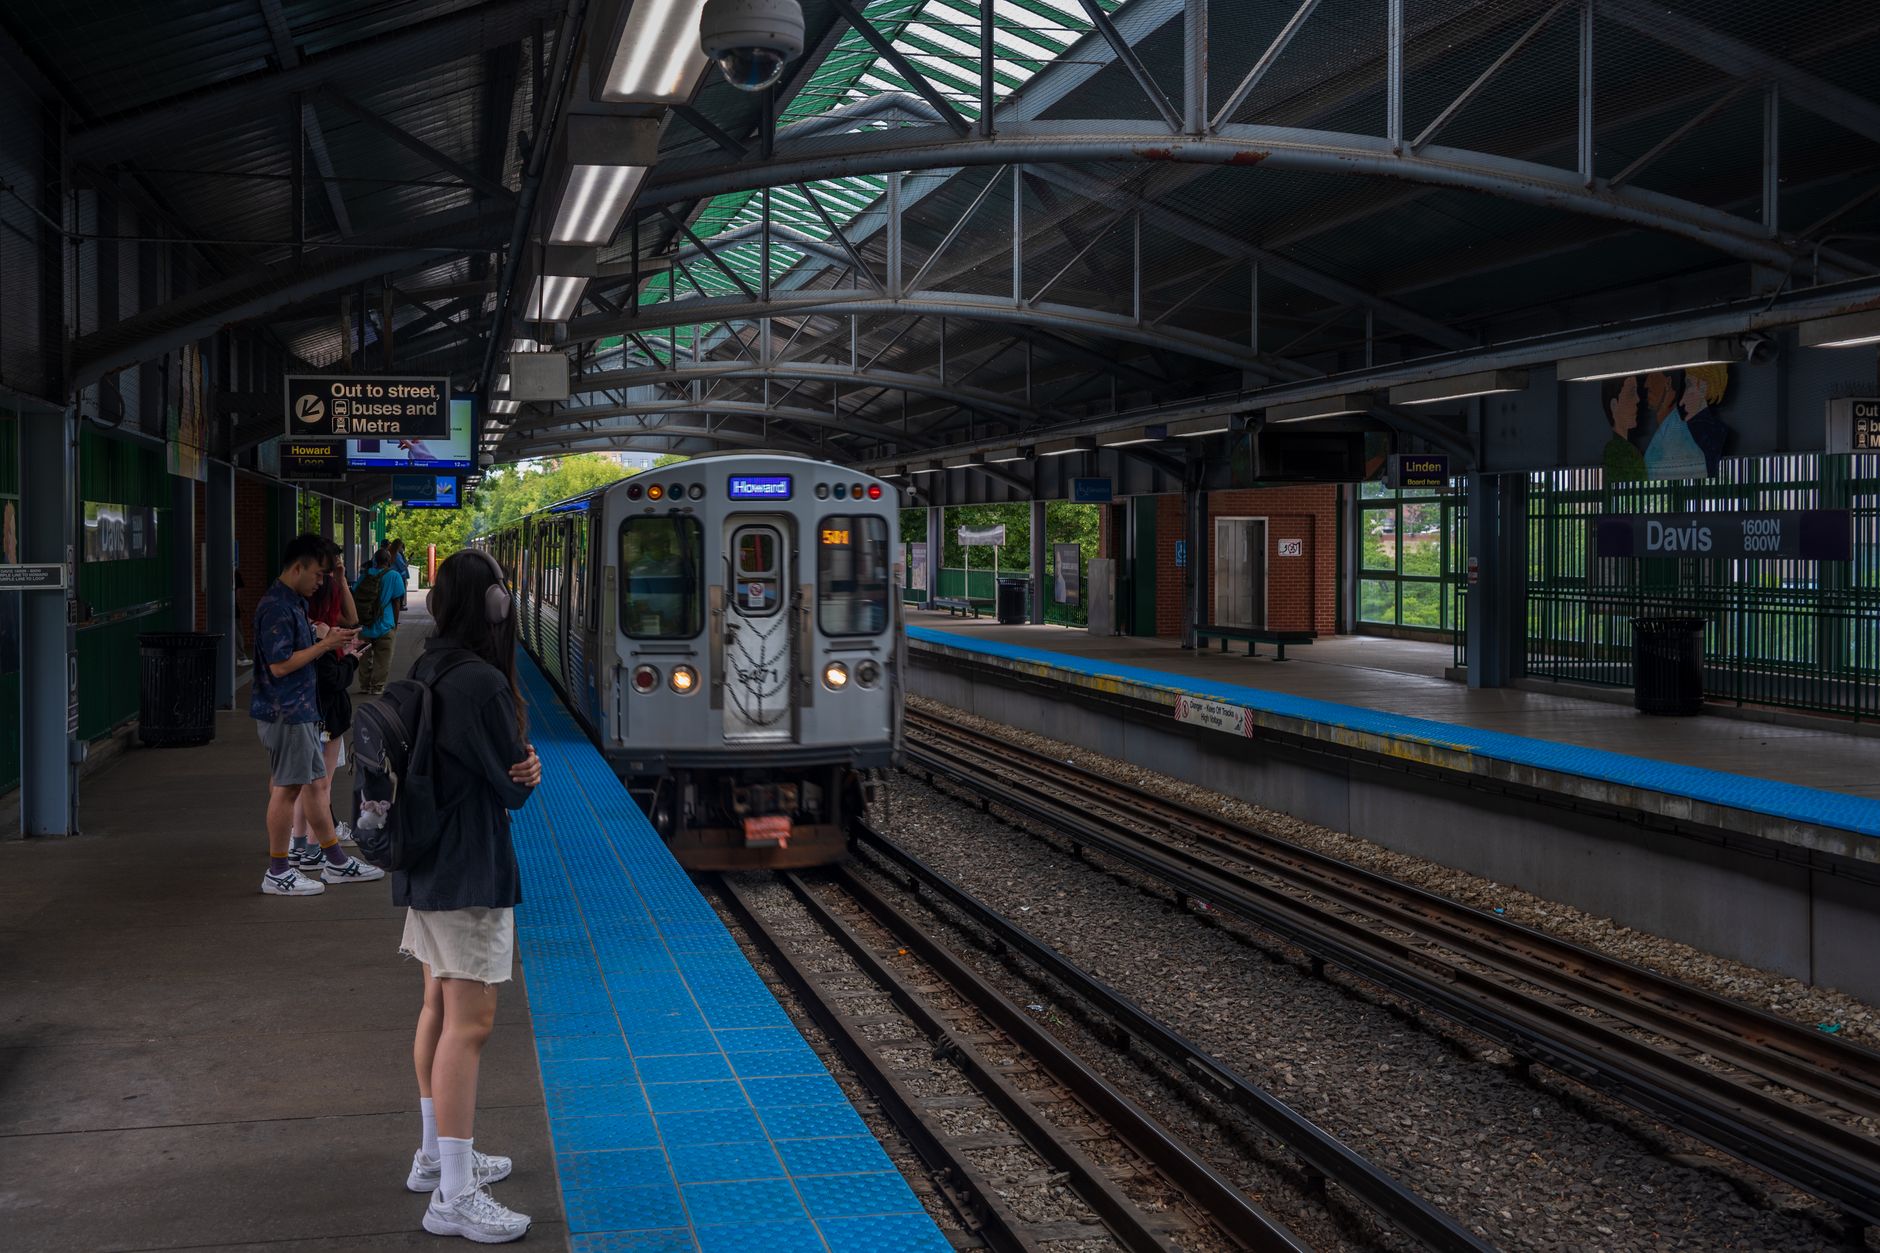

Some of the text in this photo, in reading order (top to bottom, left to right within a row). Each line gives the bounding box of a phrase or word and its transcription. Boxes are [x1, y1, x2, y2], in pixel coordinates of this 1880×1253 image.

[331, 383, 440, 401] Out to street,
[352, 401, 437, 416] buses and
[1855, 404, 1879, 417] Out
[352, 418, 401, 433] Metra
[291, 445, 331, 455] Howard
[298, 457, 325, 467] Loop
[1405, 461, 1441, 472] Linden
[732, 480, 788, 494] Howard
[1407, 478, 1426, 486] Board
[1741, 518, 1781, 536] 1600N
[1647, 519, 1713, 552] Davis
[1743, 535, 1782, 552] 800W
[1190, 701, 1202, 711] Danger
[1206, 705, 1215, 714] Keep
[1222, 707, 1234, 717] Tracks
[1201, 714, 1222, 726] High Voltage
